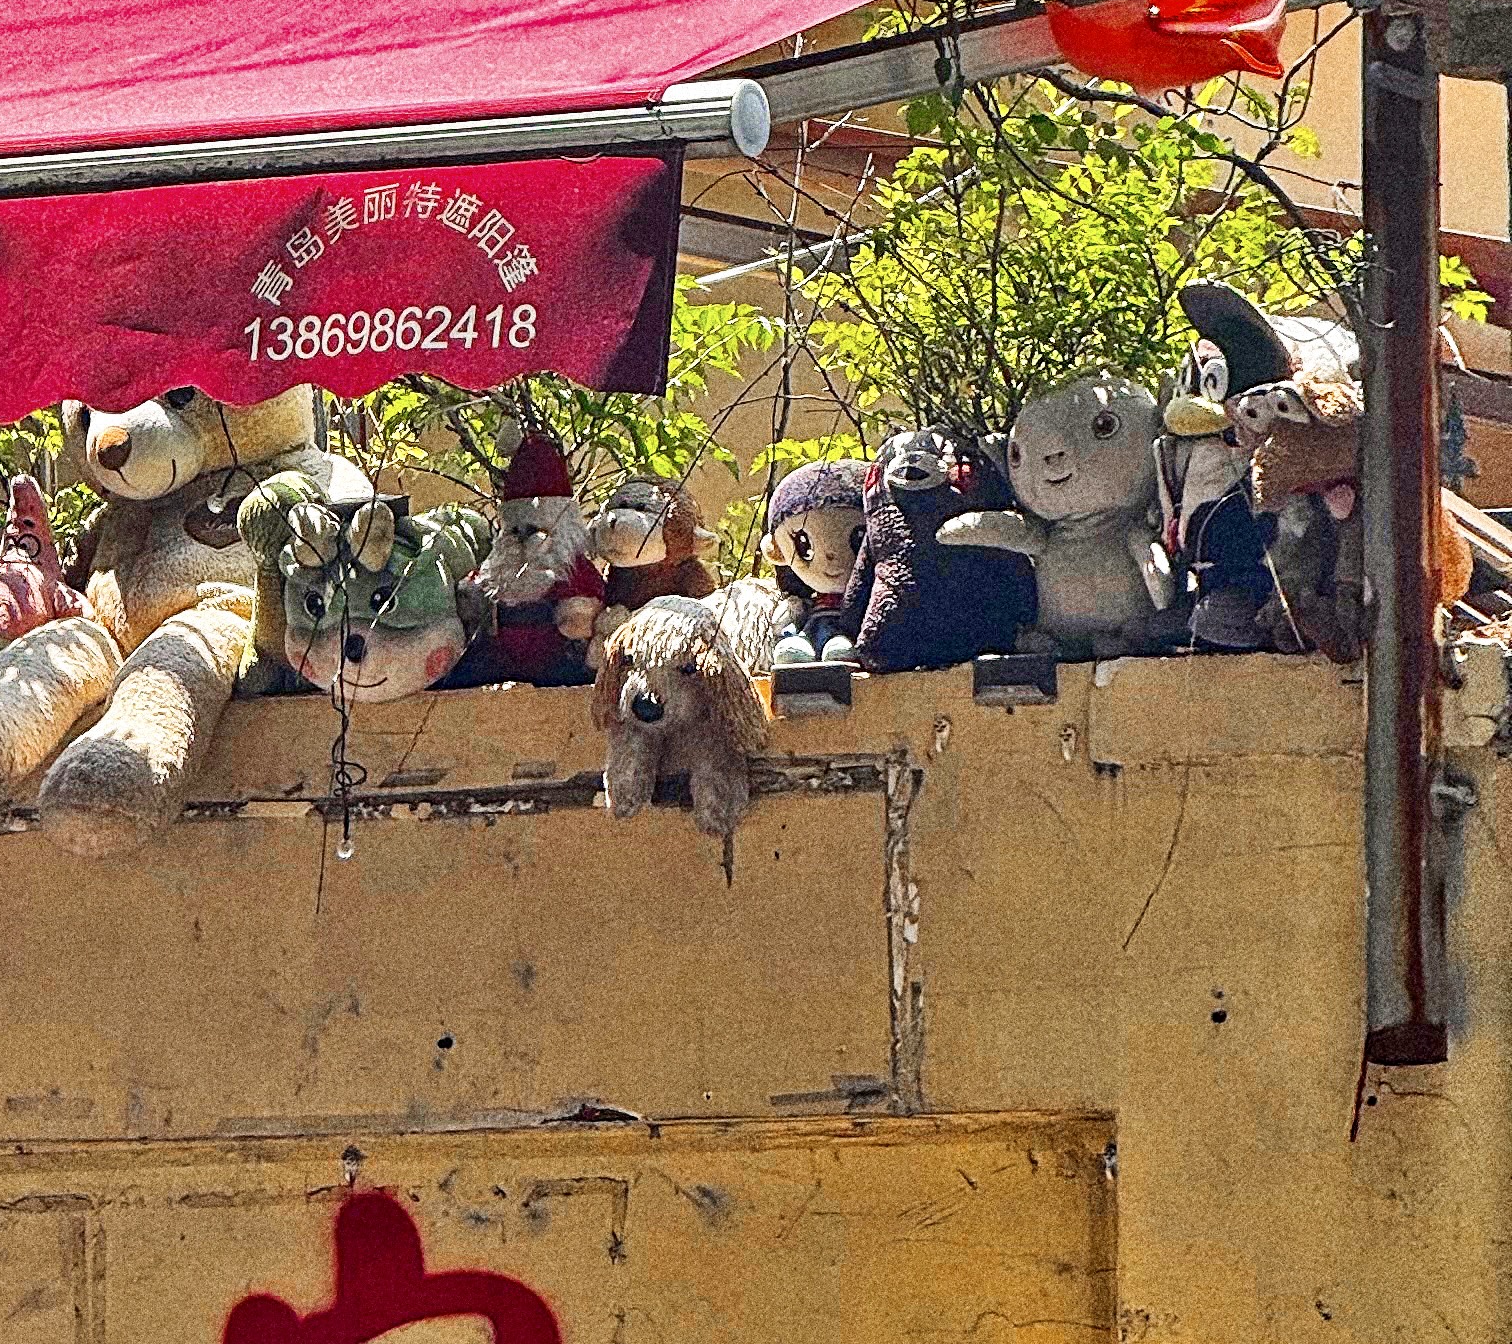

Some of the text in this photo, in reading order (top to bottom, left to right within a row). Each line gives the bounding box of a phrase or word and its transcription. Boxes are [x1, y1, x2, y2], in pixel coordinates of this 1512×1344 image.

[250, 180, 538, 306] 青岛美丽特遮阳篷
[244, 304, 537, 361] 13869862418
